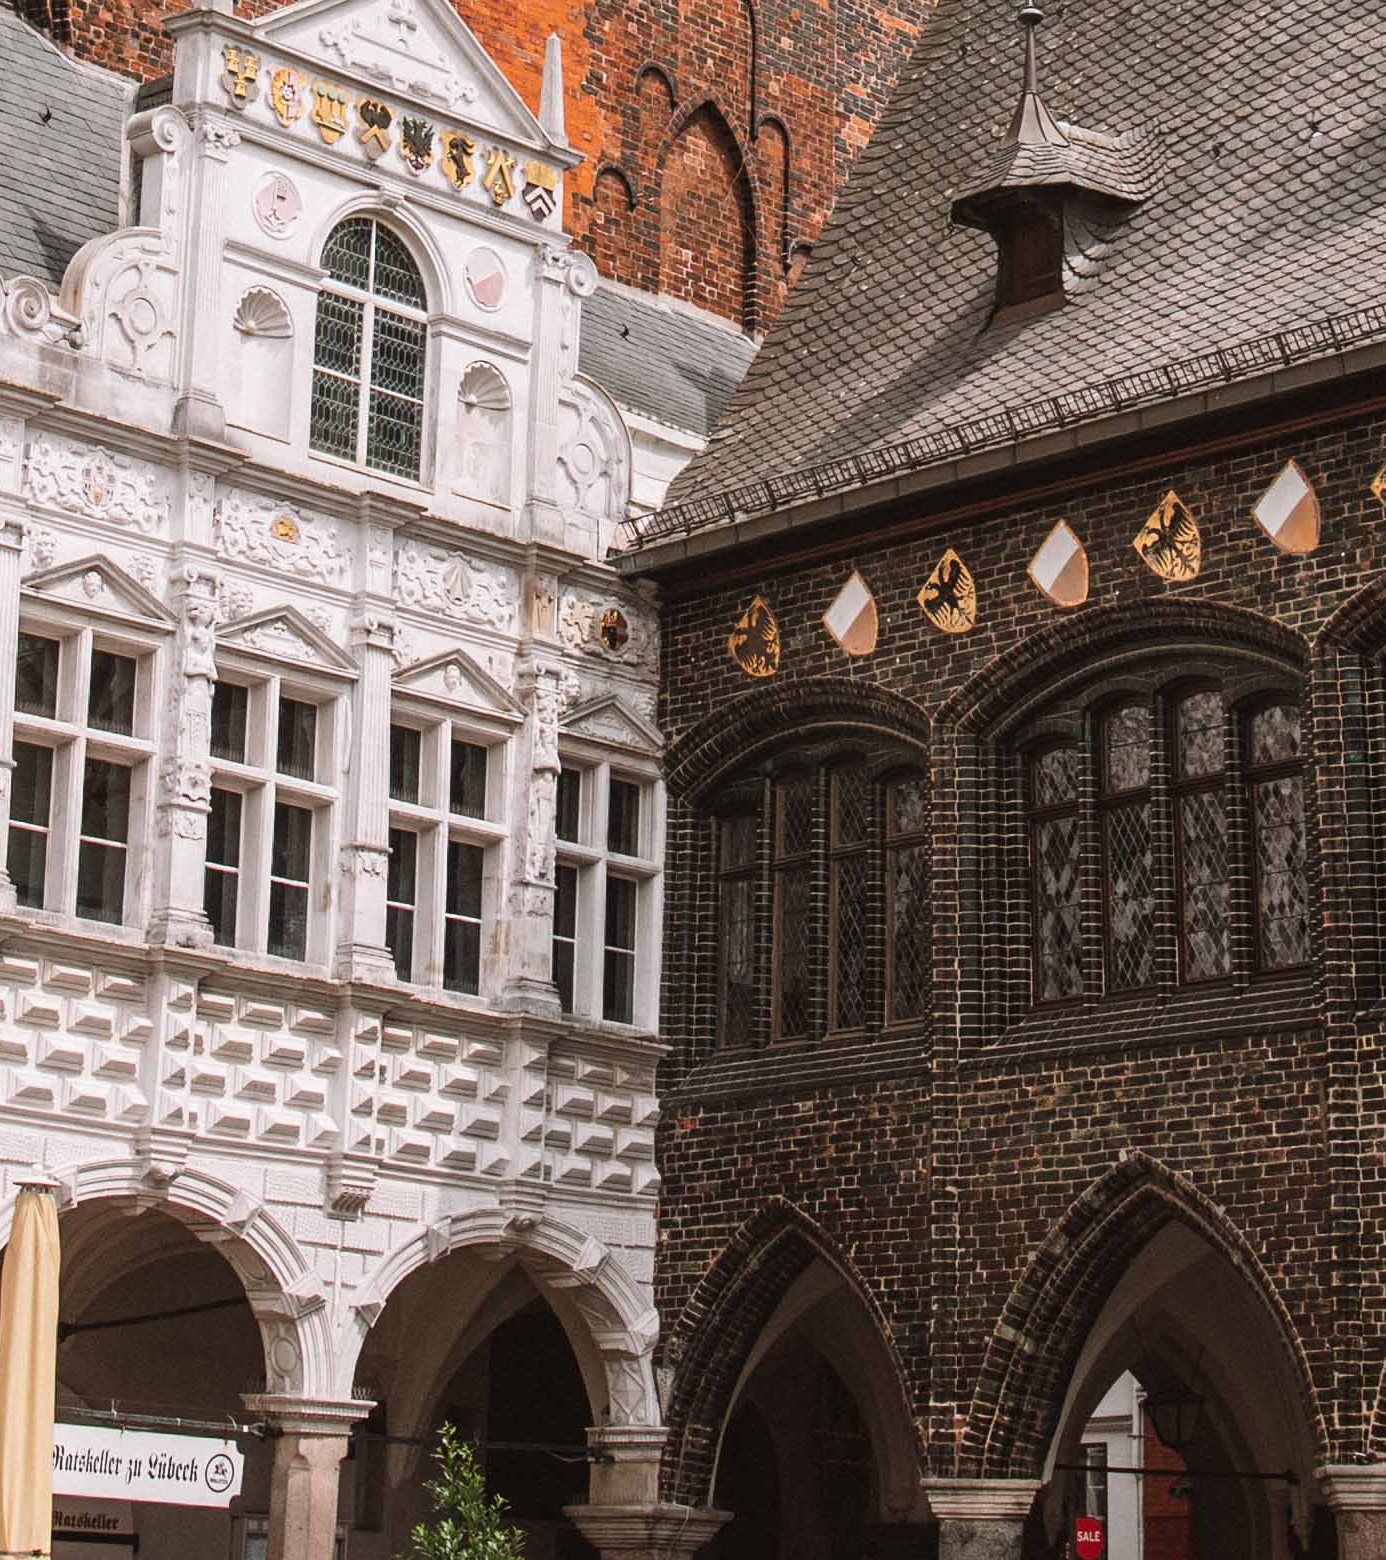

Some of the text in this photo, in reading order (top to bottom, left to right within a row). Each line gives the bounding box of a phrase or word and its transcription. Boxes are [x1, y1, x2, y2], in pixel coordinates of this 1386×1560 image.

[53, 1444, 199, 1485] Ratskeller zu Lübeck
[1077, 1531, 1101, 1542] SALE
